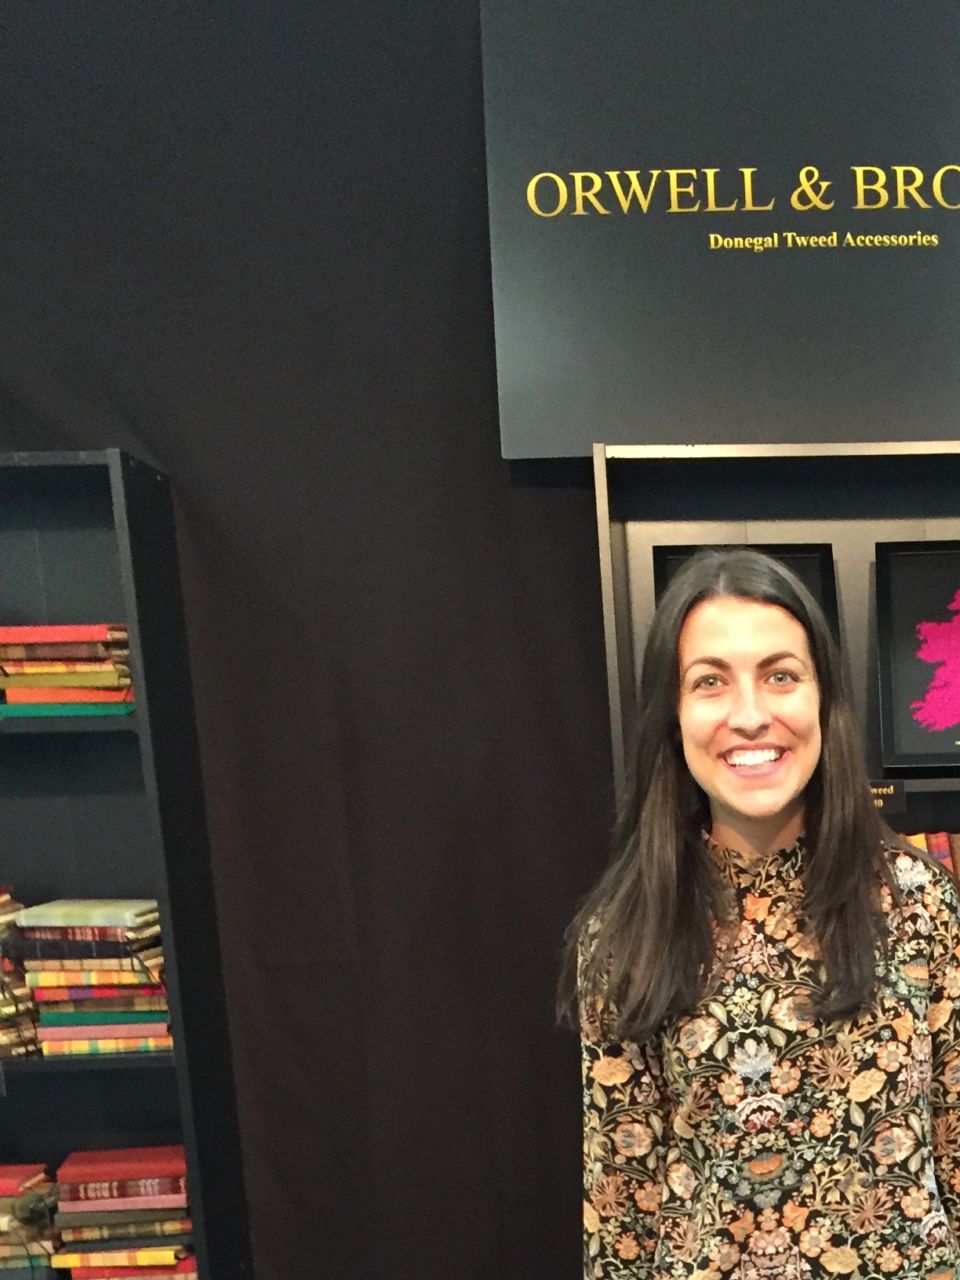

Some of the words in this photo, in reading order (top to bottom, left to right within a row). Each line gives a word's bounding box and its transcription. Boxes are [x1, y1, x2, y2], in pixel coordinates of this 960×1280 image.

[526, 167, 776, 218] ORWELL
[789, 165, 835, 211] &
[708, 232, 779, 253] Donegal
[782, 231, 838, 249] Tweed
[842, 230, 940, 248] Accessories
